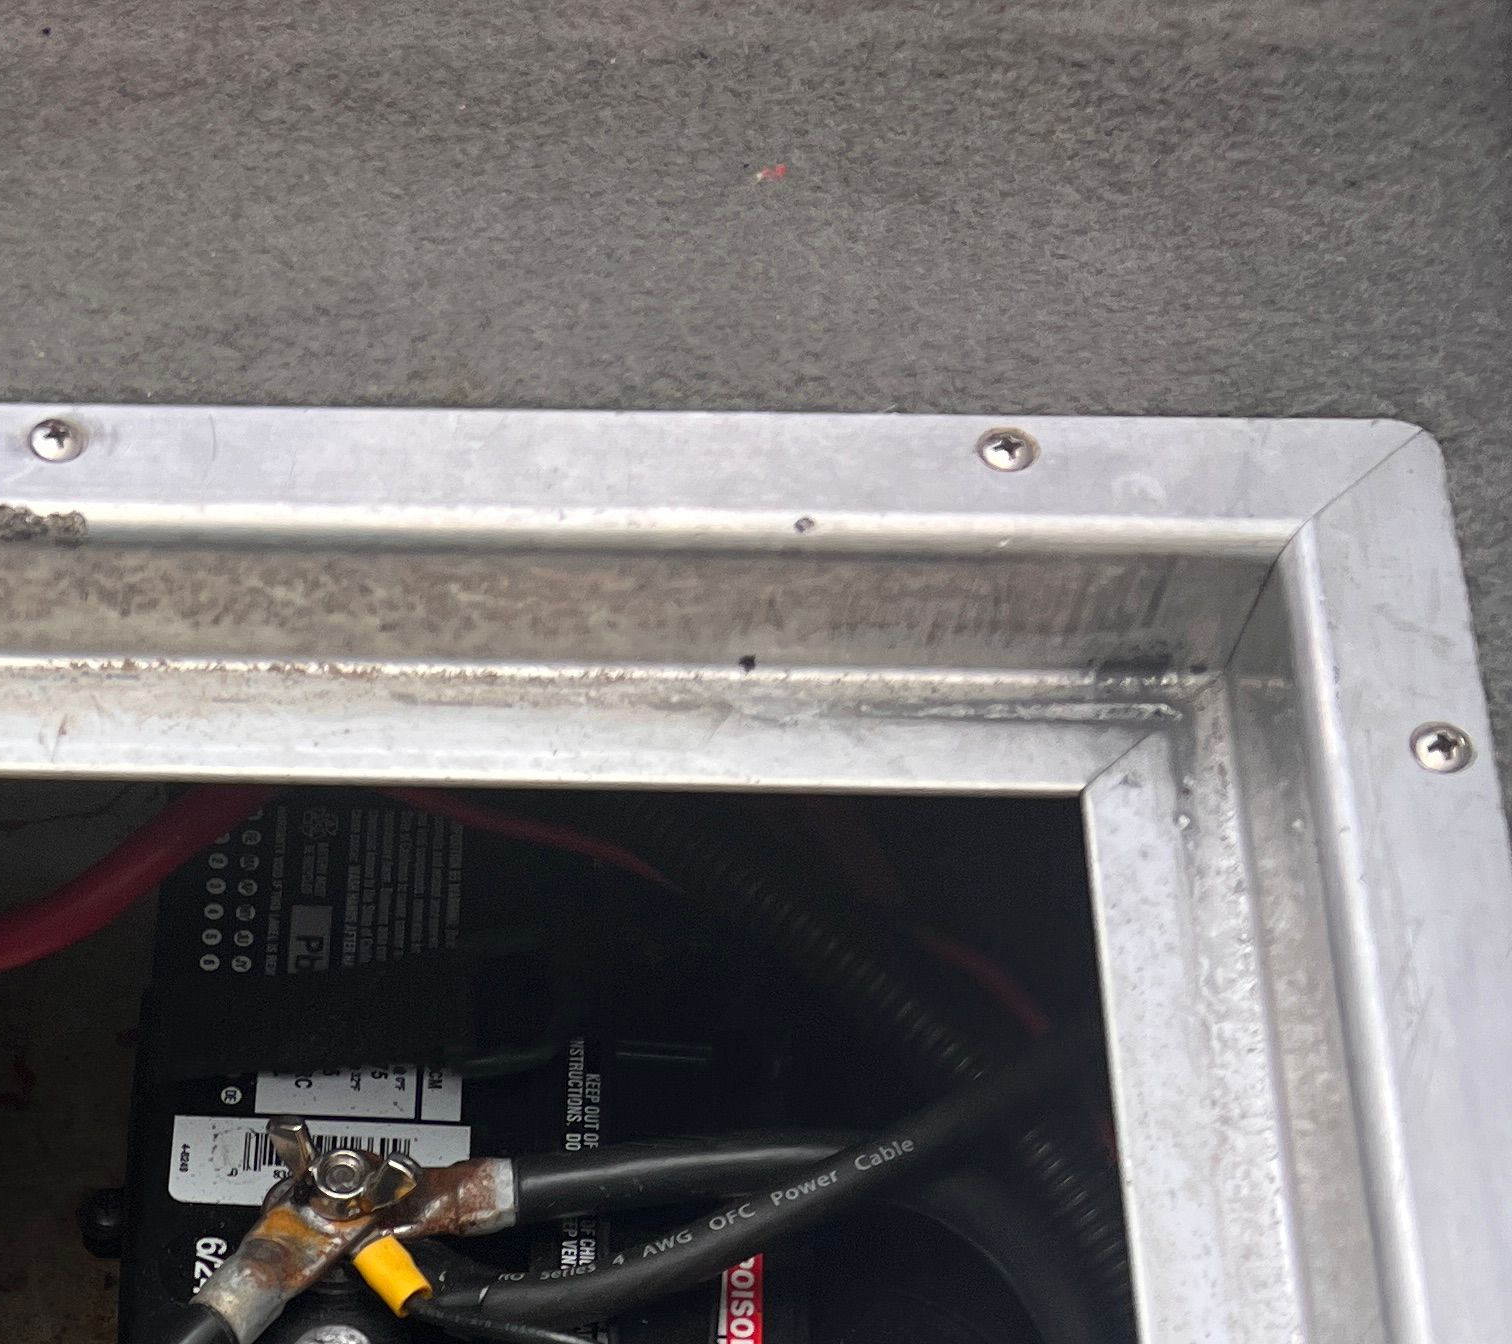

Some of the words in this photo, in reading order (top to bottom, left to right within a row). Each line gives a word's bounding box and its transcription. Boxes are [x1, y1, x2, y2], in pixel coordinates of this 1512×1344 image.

[343, 924, 359, 953] AFTER
[565, 1040, 585, 1127] NSTRUCTIONS.
[585, 1073, 601, 1103] KEEP
[583, 1106, 601, 1131] OUT
[565, 1132, 582, 1151] DO
[583, 1133, 600, 1150] OF
[611, 1252, 625, 1267] 4
[641, 1228, 693, 1259] AWG
[707, 1201, 757, 1232] OFC
[769, 1169, 839, 1207] Power
[853, 1138, 916, 1172] Cable
[192, 1236, 229, 1295] 6/2
